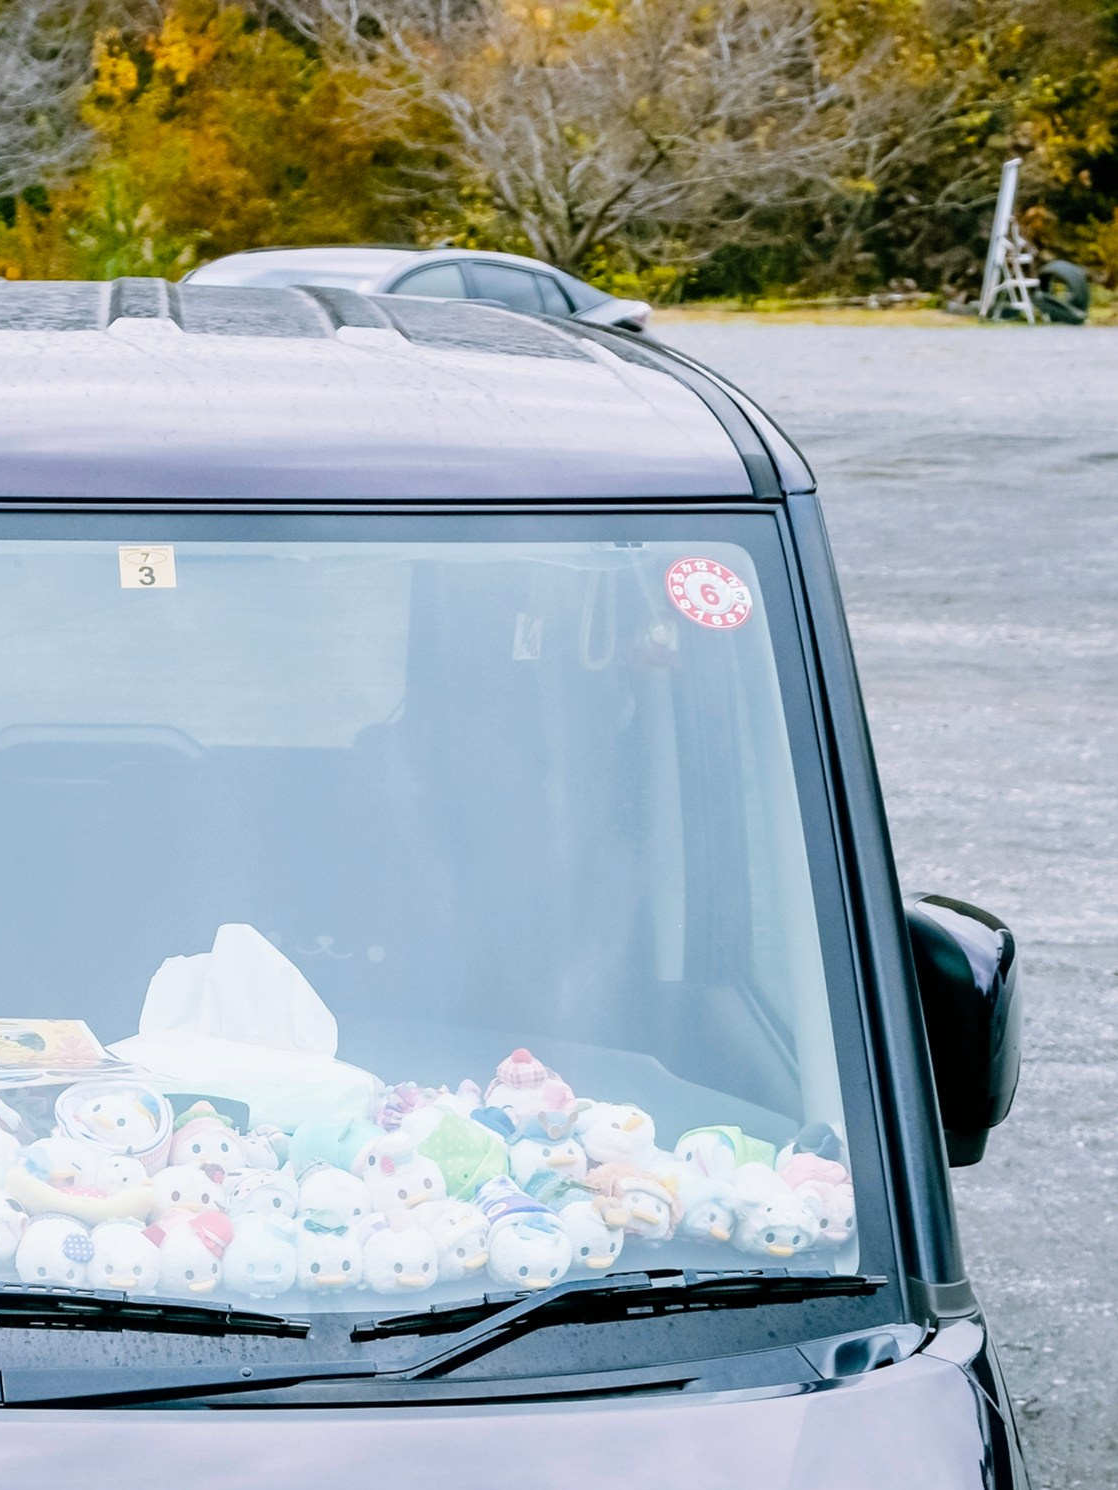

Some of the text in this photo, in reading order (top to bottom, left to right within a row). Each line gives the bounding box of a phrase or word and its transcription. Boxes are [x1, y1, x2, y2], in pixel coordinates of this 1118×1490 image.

[140, 552, 150, 563] 7
[680, 563, 692, 573] 11
[694, 561, 708, 571] 12
[138, 565, 156, 586] 3
[671, 573, 685, 583] 10
[672, 585, 683, 595] 9
[700, 583, 720, 606] 6
[680, 599, 691, 610] 8
[735, 604, 745, 614] 4
[694, 610, 704, 620] 7
[711, 615, 723, 625] 6
